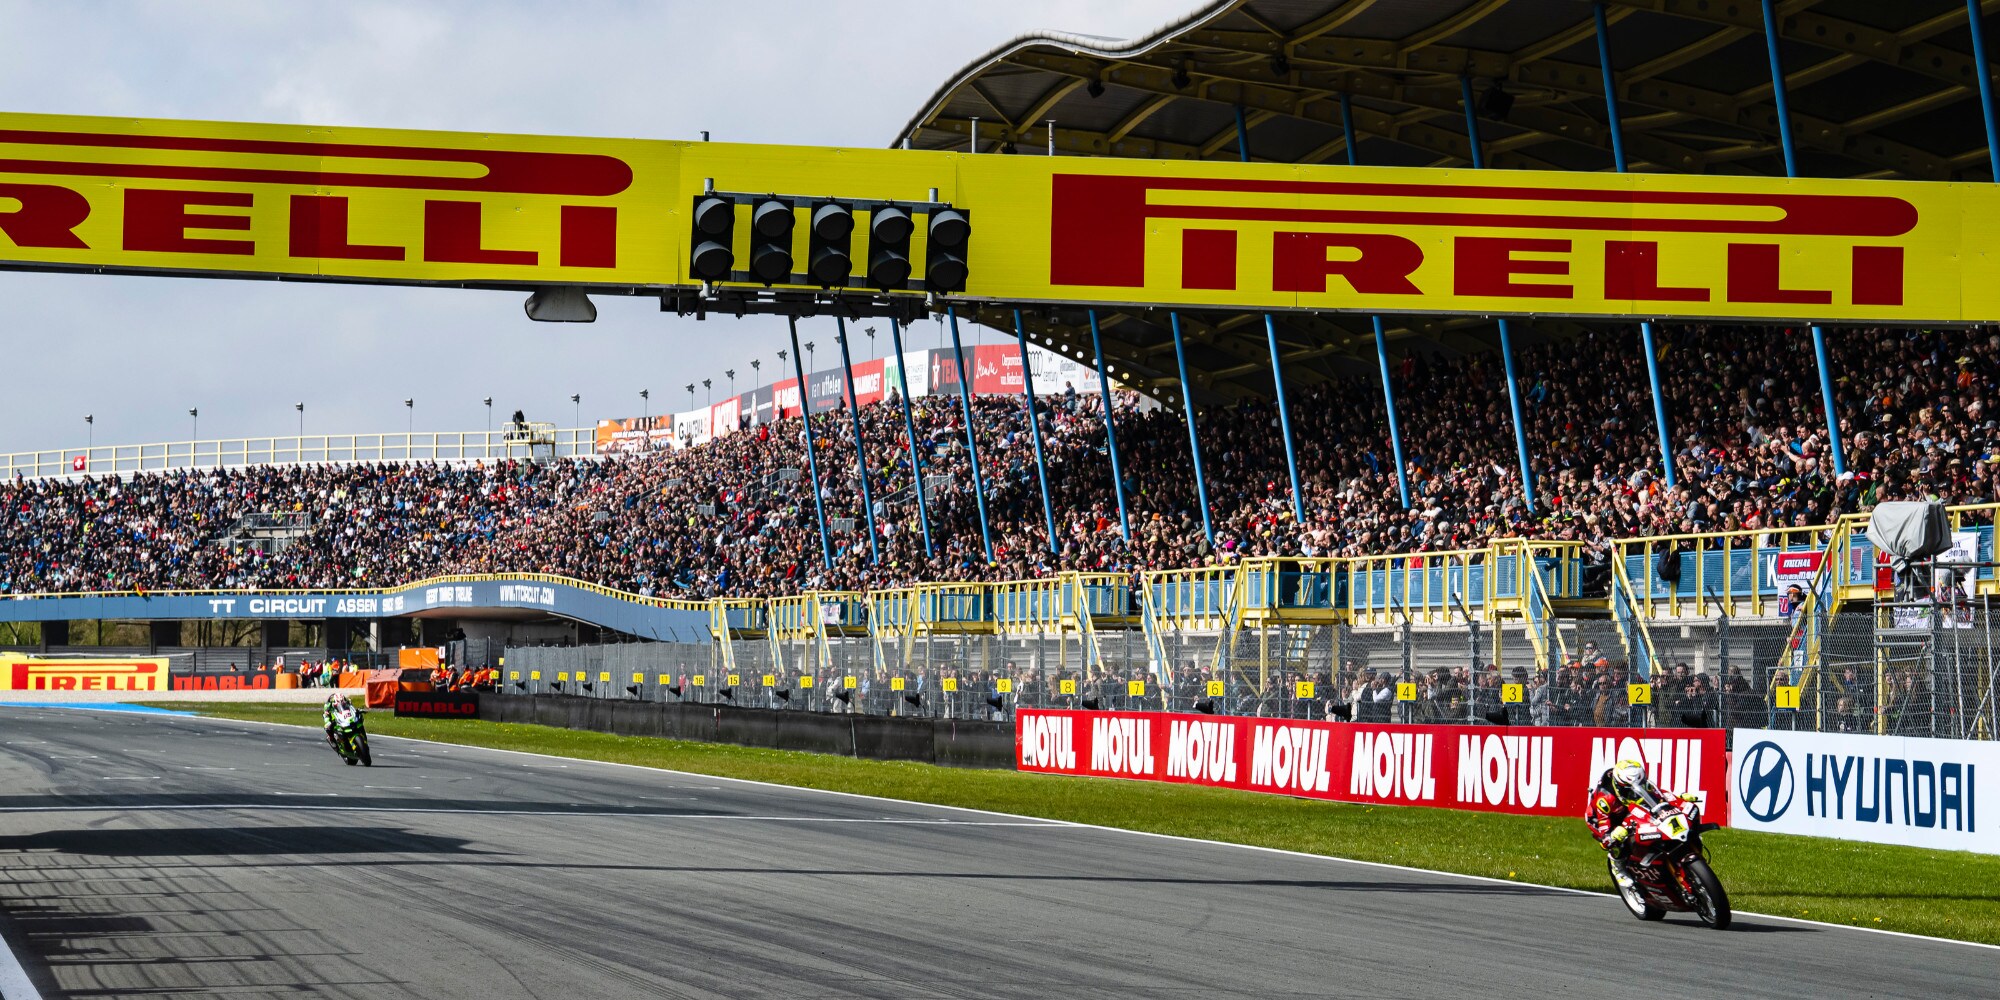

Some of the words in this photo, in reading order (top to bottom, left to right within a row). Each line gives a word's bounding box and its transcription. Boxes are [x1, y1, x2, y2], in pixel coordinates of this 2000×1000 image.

[0, 130, 634, 269] RELLI
[1050, 172, 1919, 306] PIRELLI
[941, 357, 970, 384] TEXAO
[208, 599, 236, 613] TT
[249, 599, 327, 613] CIRCUIT
[336, 598, 378, 613] ASSEN
[12, 663, 158, 691] PIRELLI
[173, 673, 269, 691] DIABLO
[765, 676, 774, 685] 14
[802, 677, 811, 687] 13
[846, 678, 855, 688] 12
[893, 679, 902, 689] 11
[945, 680, 955, 690] 10
[1000, 680, 1007, 691] 9
[1064, 681, 1072, 693] 8
[1134, 683, 1141, 694] 7
[1211, 683, 1219, 695] 6
[1301, 683, 1309, 697] 5
[1401, 685, 1411, 699] 4
[1508, 686, 1517, 701] 3
[1635, 686, 1645, 703] 2
[1784, 689, 1790, 707] 1
[398, 701, 476, 714] DIABLO
[1022, 714, 1076, 770] MOTUL
[1090, 716, 1155, 775] MOTUL
[1166, 720, 1237, 783] MOTUL
[1250, 724, 1331, 792] MOTUL
[1349, 730, 1436, 801] MOTUL
[1456, 733, 1559, 808] MOTUL
[1806, 752, 1975, 833] HYUNDAI
[1639, 833, 1662, 841] Lenovo
